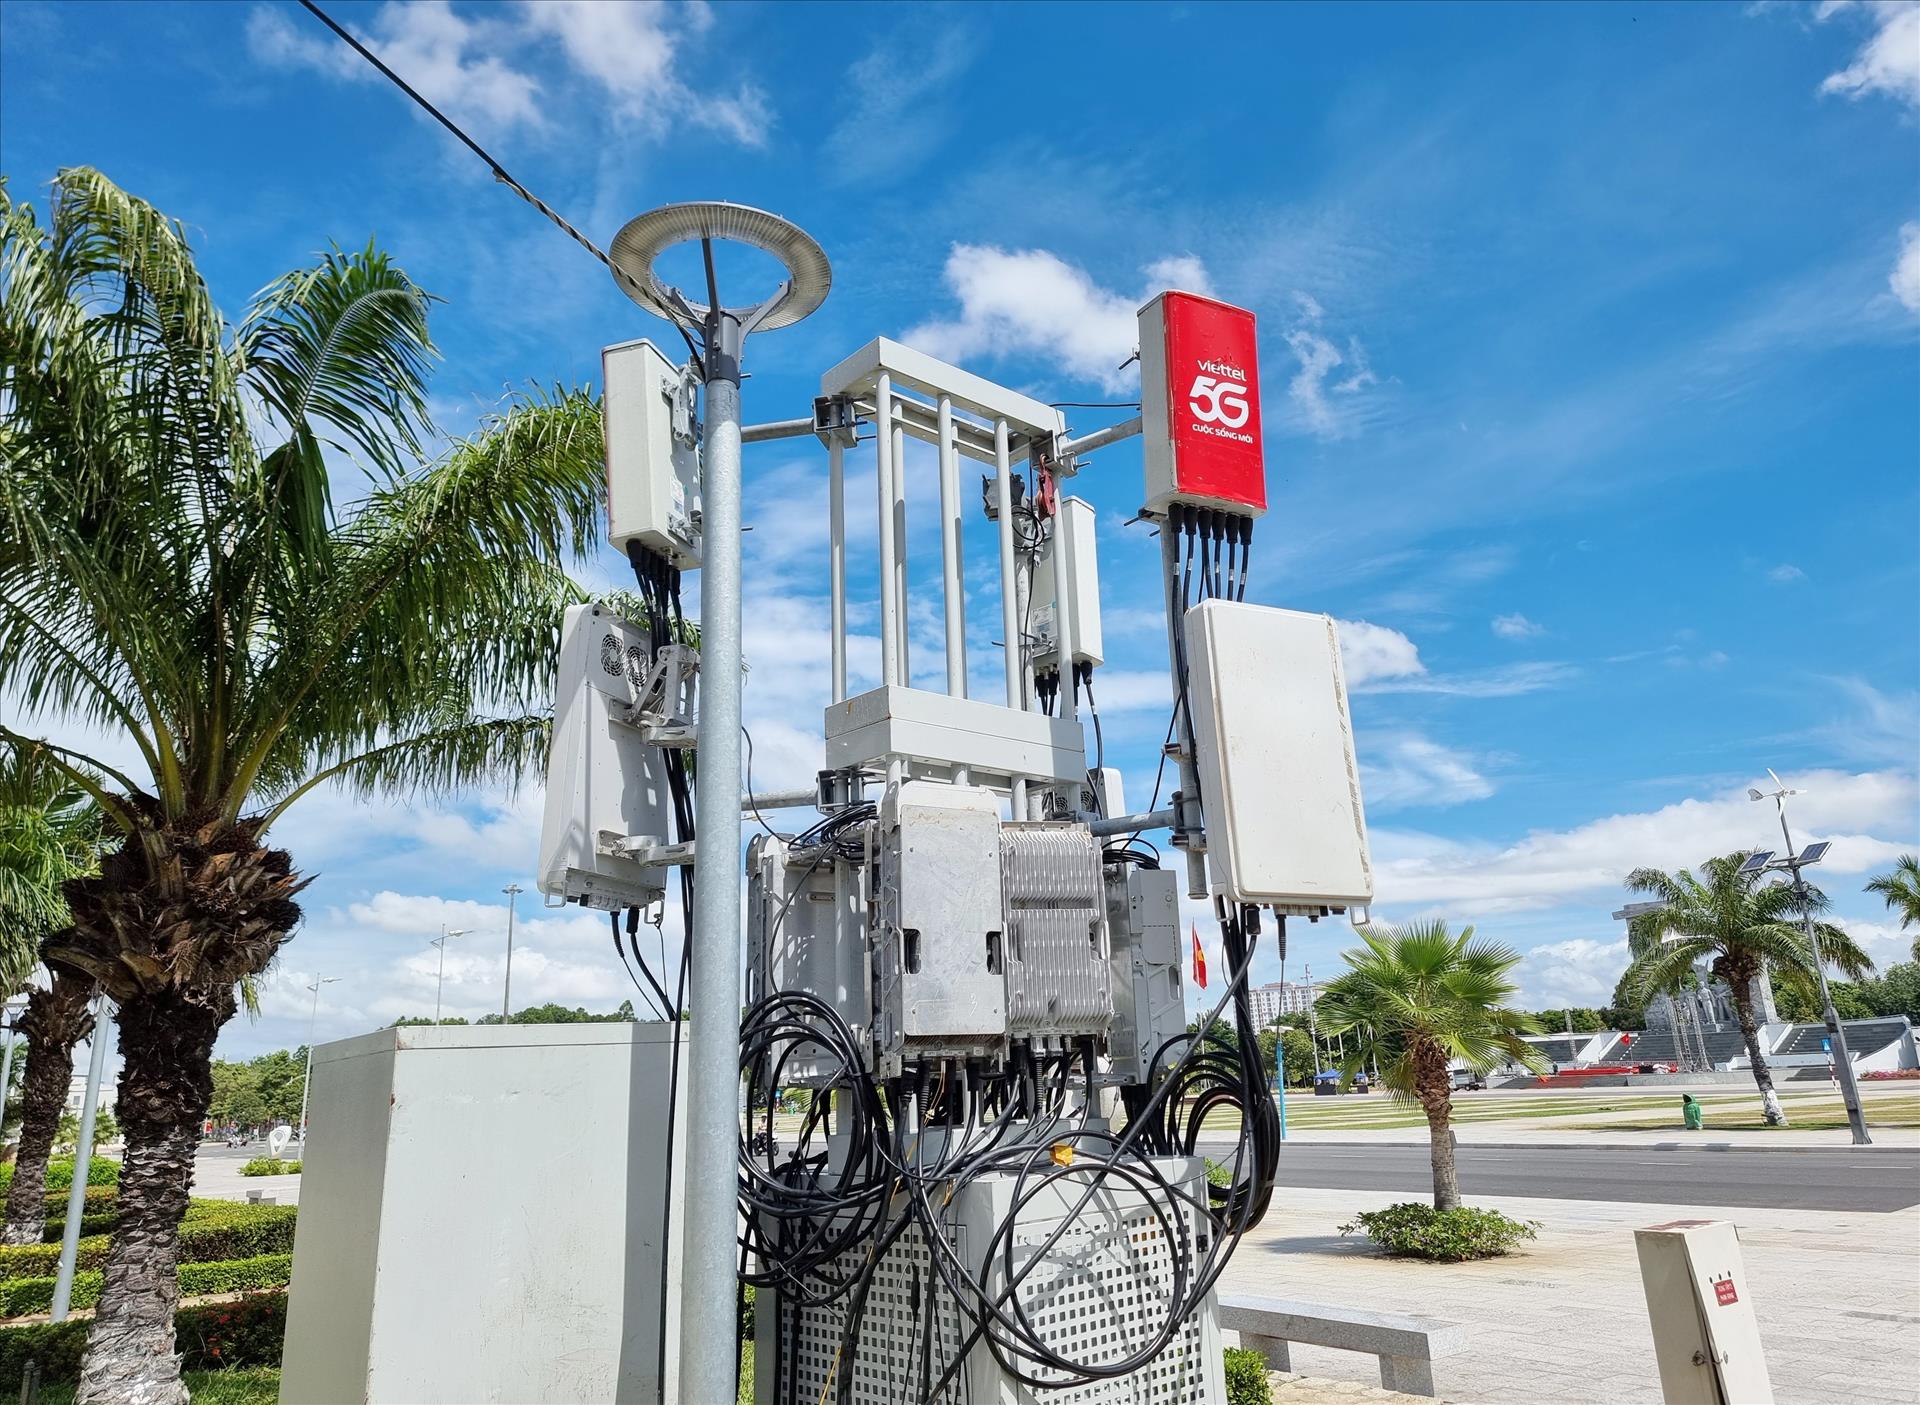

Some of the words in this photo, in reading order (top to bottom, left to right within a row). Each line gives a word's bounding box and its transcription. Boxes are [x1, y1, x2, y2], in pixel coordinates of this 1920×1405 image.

[1197, 360, 1247, 382] viettel
[1189, 375, 1249, 429] 5G
[1192, 423, 1215, 435] CUỘC
[1215, 427, 1237, 440] SỐNG
